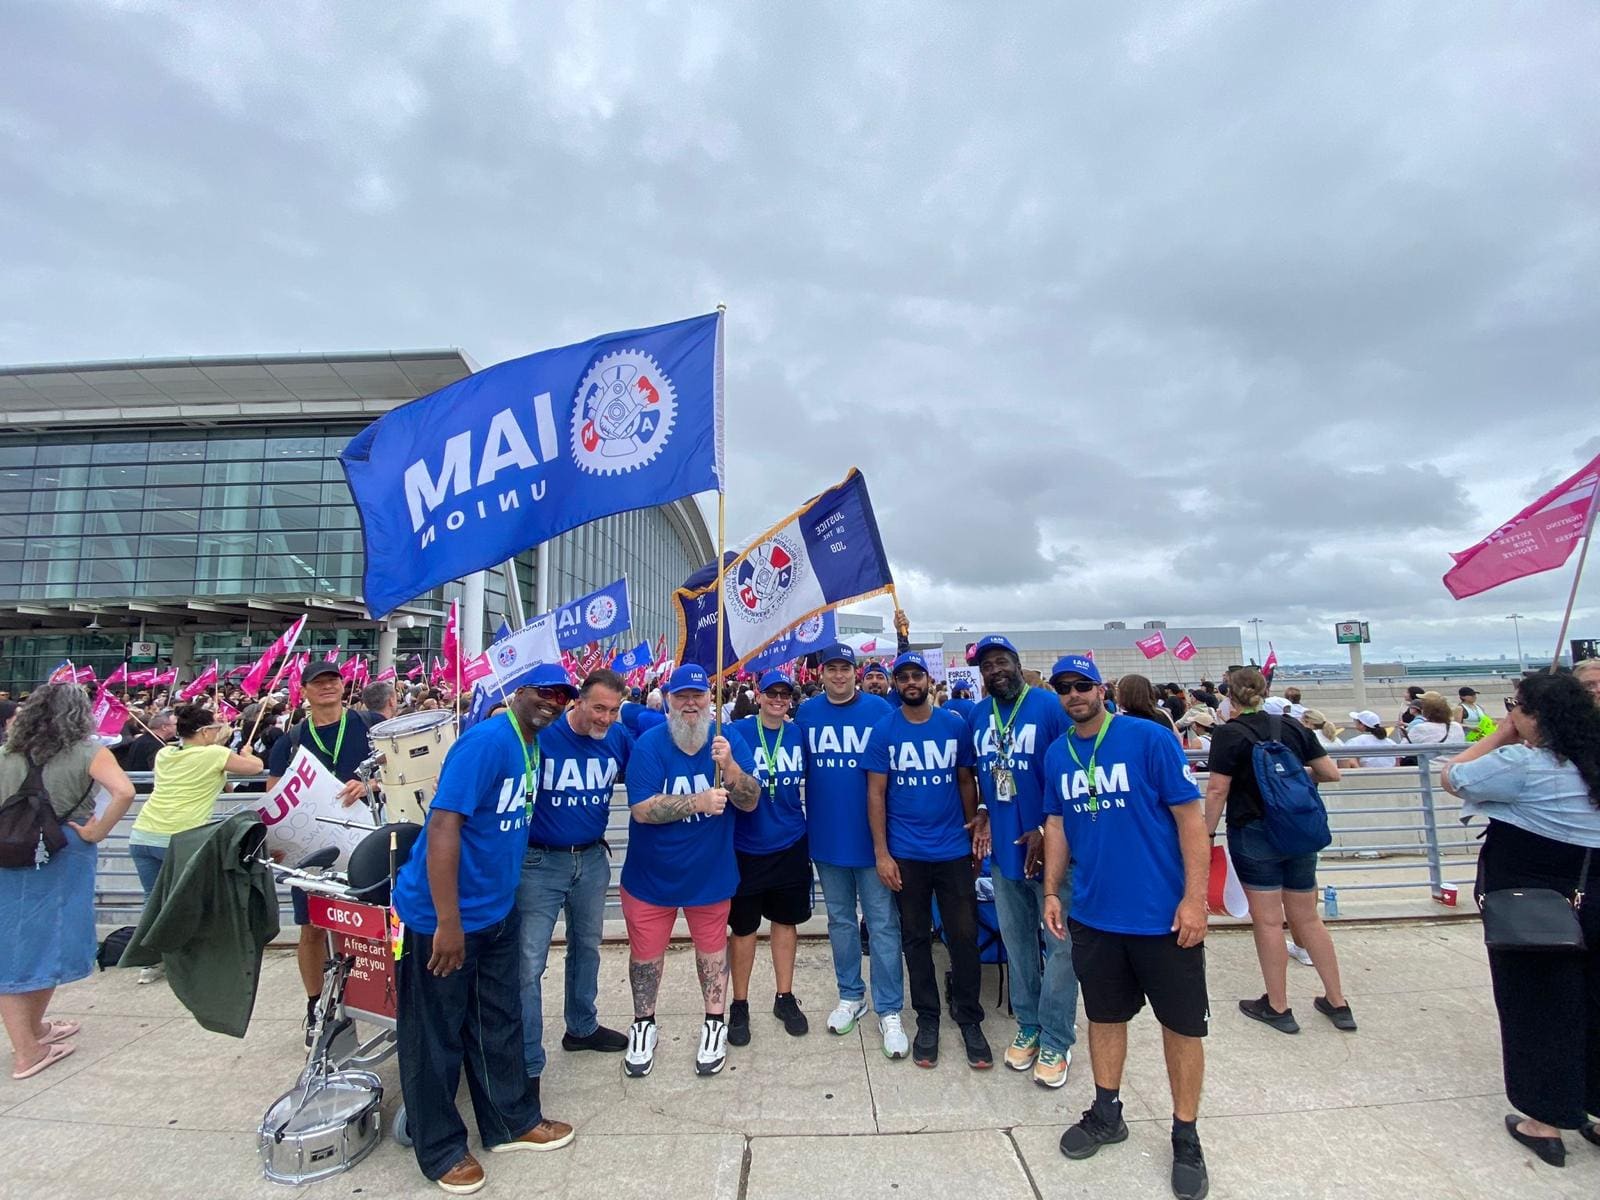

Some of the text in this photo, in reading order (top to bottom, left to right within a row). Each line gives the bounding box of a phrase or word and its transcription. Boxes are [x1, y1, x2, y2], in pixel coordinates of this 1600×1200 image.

[1073, 659, 1090, 668] IAM
[816, 759, 857, 768] UNIO
[888, 739, 958, 771] IAM
[543, 758, 618, 791] IAM
[896, 774, 952, 786] UNION
[1061, 763, 1130, 800] IAM
[257, 756, 317, 826] UPE
[551, 793, 609, 807] UNION
[327, 907, 352, 925] CIBC
[344, 937, 386, 957] A free cart
[355, 956, 369, 968] get
[370, 959, 385, 971] you
